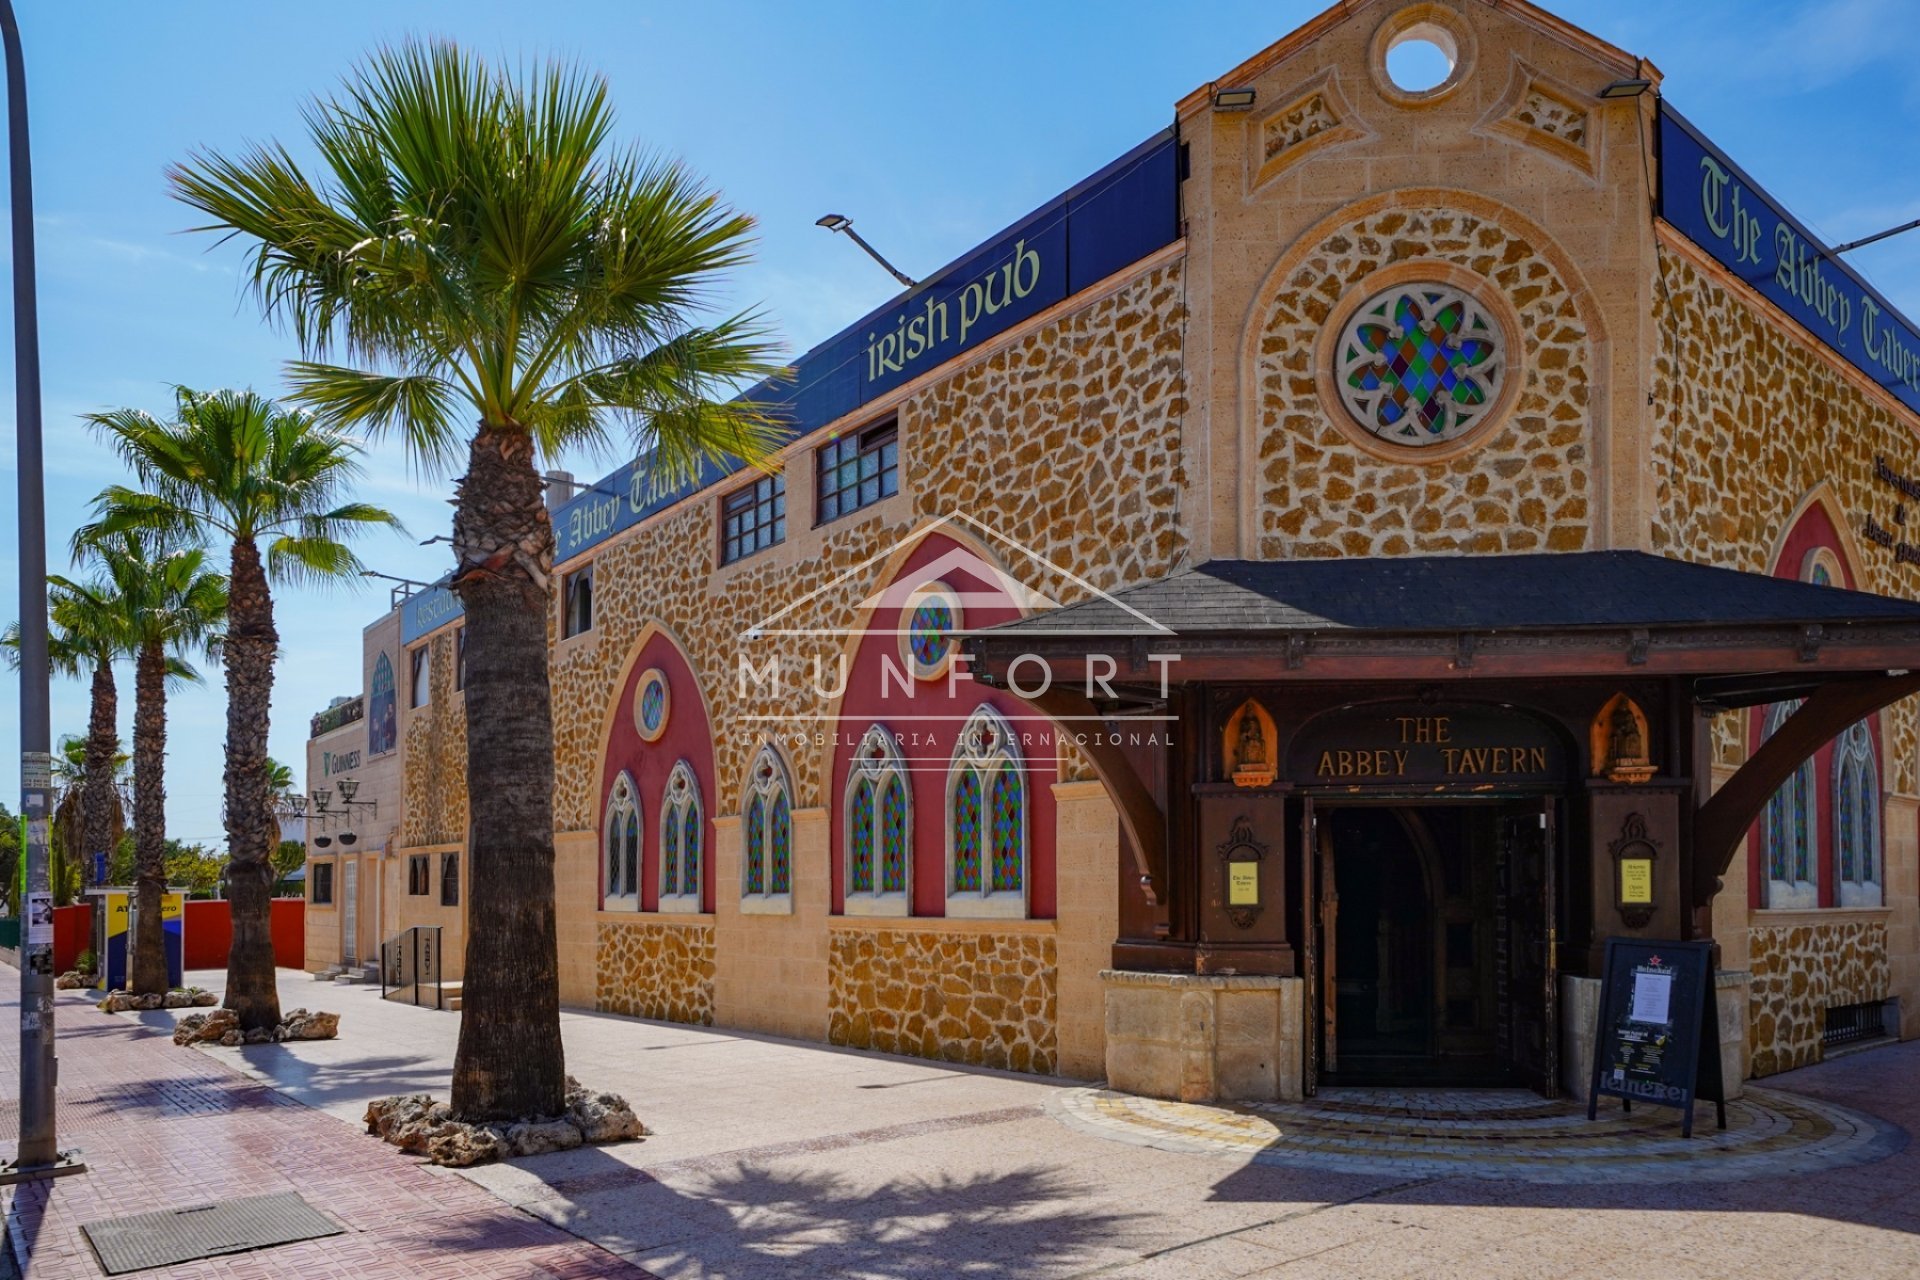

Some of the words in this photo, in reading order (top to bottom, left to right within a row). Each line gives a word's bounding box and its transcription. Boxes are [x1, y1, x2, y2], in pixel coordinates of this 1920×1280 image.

[1700, 156, 1762, 265] The
[1774, 222, 1850, 348] Abbey
[958, 239, 1040, 345] pub
[569, 493, 621, 548] Abbey
[1396, 717, 1452, 743] THE
[1317, 750, 1409, 776] ABBEY
[1440, 747, 1547, 775] TAVERN
